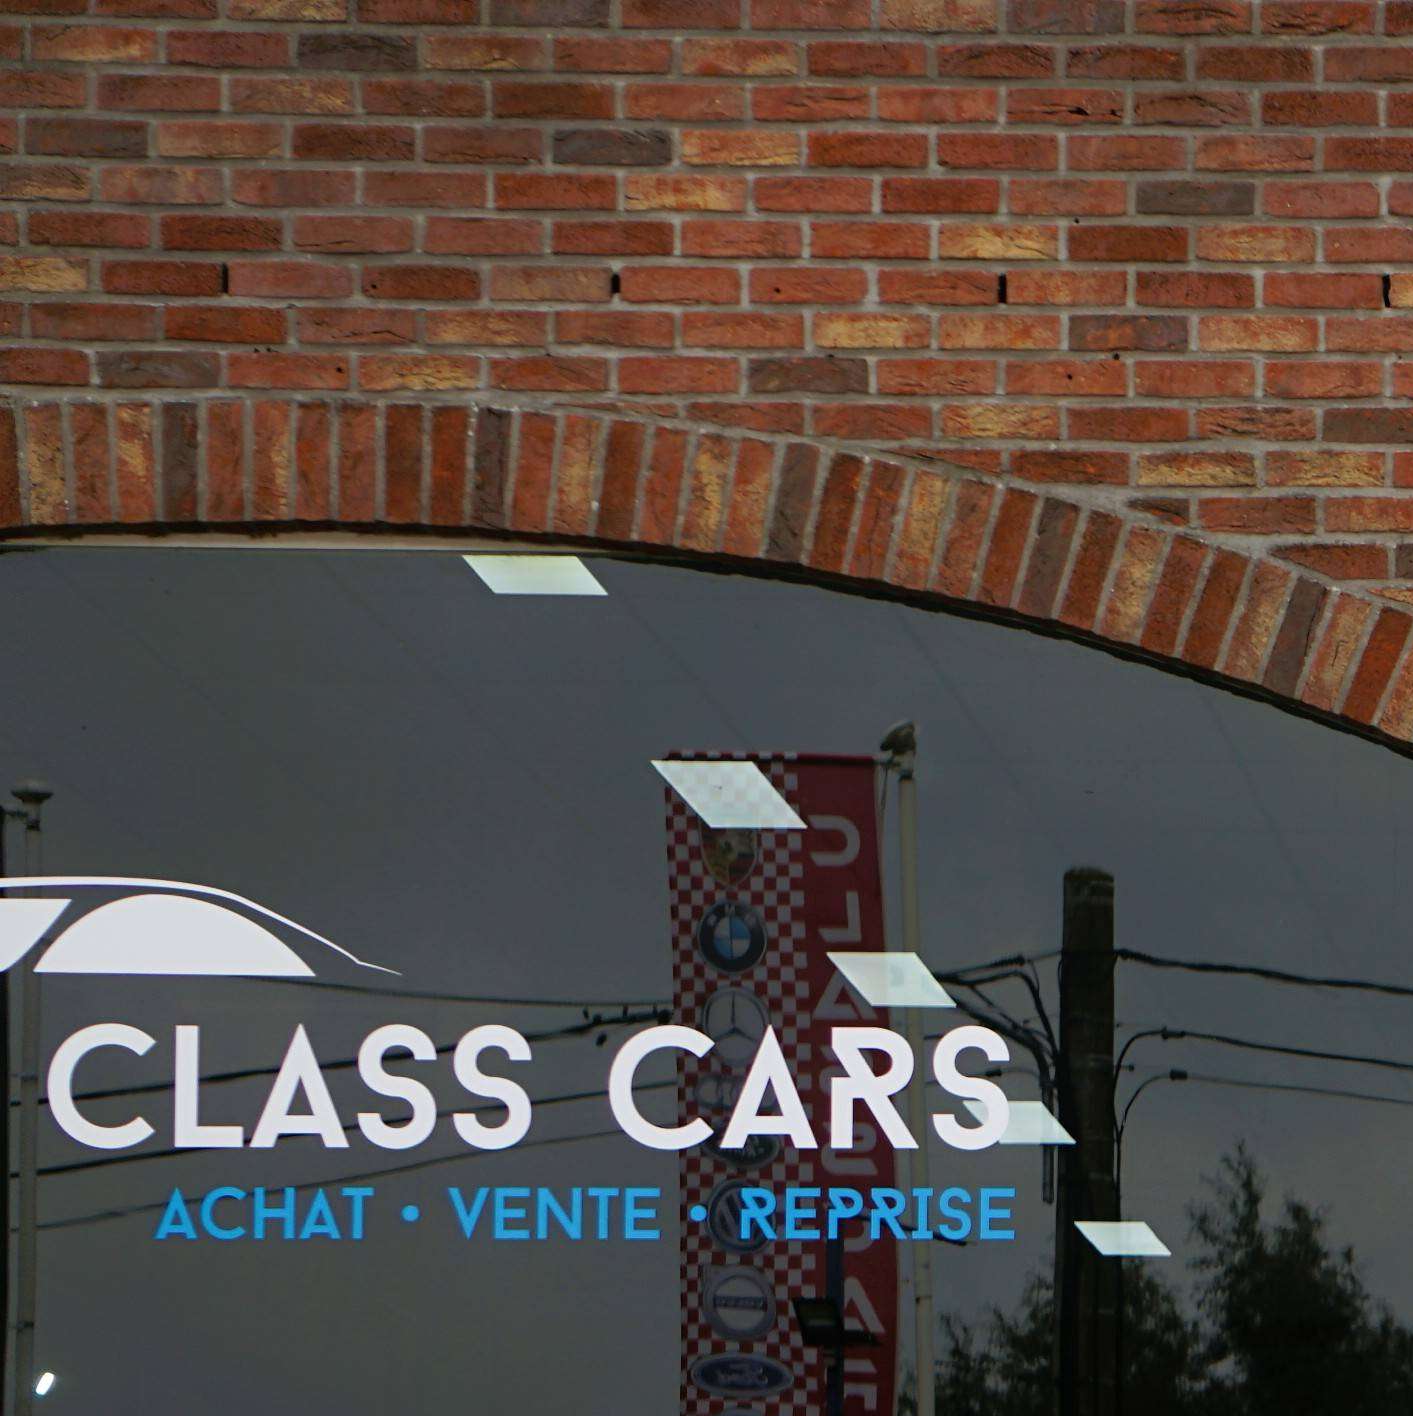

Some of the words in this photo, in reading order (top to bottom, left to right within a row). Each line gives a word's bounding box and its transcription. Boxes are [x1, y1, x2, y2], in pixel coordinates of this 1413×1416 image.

[46, 1023, 532, 1150] CLASS
[607, 1024, 1011, 1150] CARS
[154, 1186, 375, 1242] ACHAT
[447, 1186, 662, 1242] VENTE
[737, 1186, 1017, 1242] REPRISE
